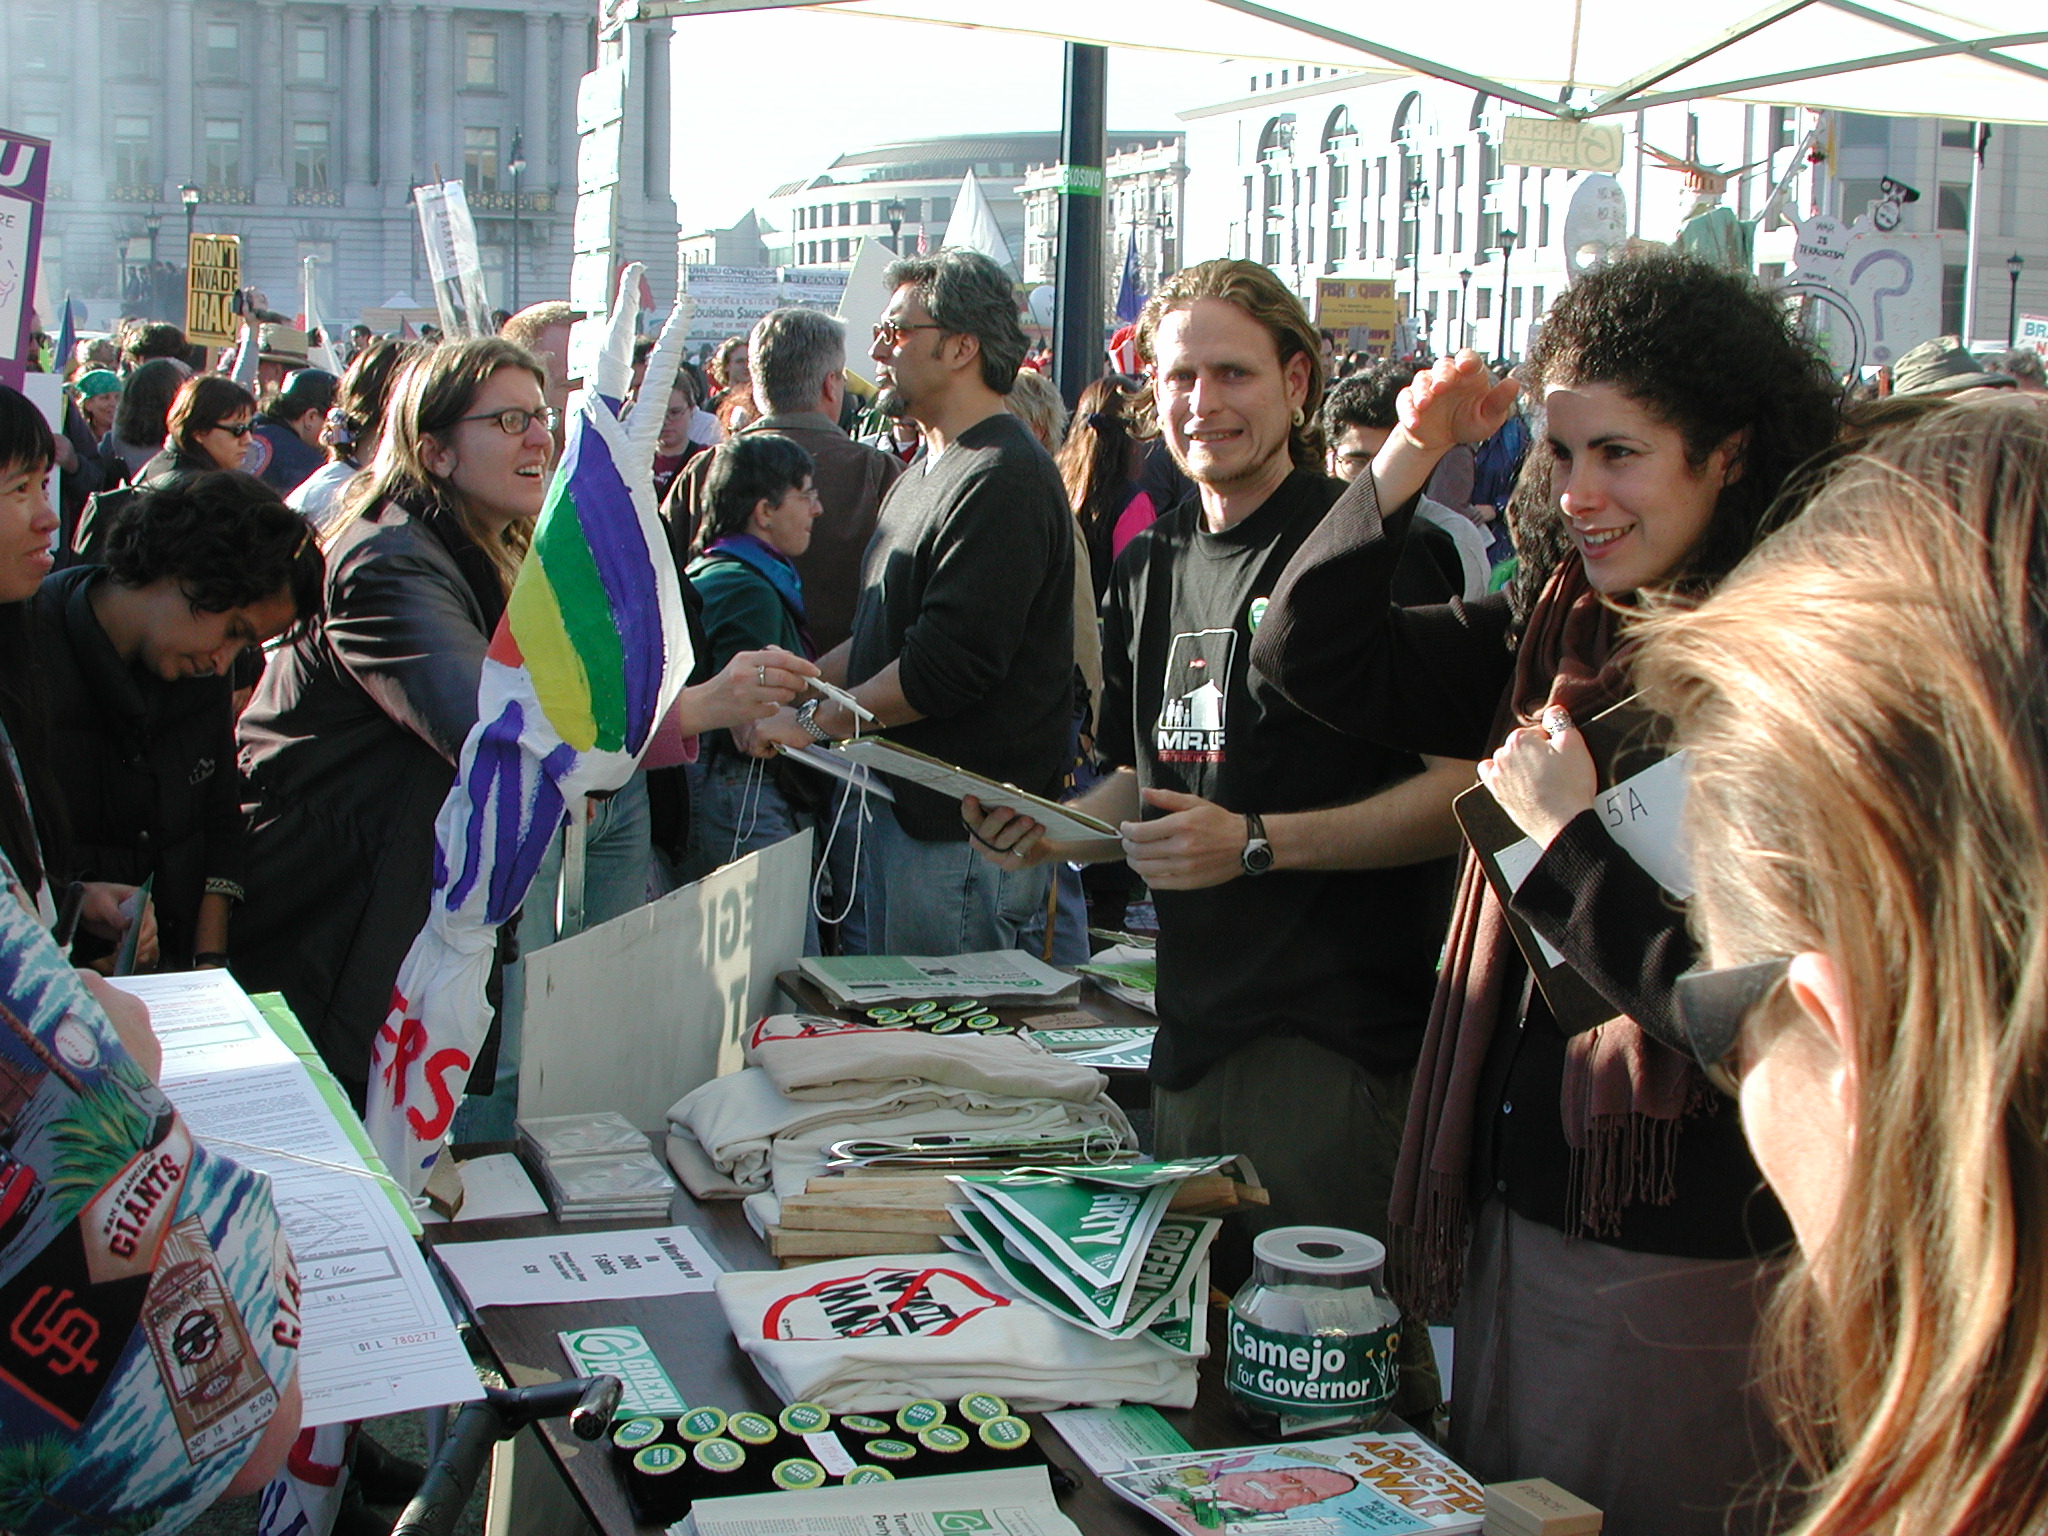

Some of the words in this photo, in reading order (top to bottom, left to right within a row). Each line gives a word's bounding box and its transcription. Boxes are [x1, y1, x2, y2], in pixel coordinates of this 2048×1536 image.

[1069, 168, 1100, 188] KOSOVO
[1816, 221, 1835, 234] WAR
[1817, 235, 1828, 245] IS
[192, 240, 237, 268] DON'T
[1799, 243, 1845, 260] TERRORISM
[192, 268, 238, 291] INVADE
[190, 292, 236, 337] IRAQ
[103, 1208, 118, 1235] SAN
[115, 1152, 156, 1206] FRANCISCO
[108, 1153, 182, 1260] GIANTS
[1070, 1193, 1140, 1245] ARTY
[591, 1253, 618, 1275] T-shirts
[617, 1254, 643, 1270] 2003
[1141, 1225, 1196, 1293] GREEN
[332, 1265, 356, 1277] Voter
[358, 1342, 371, 1352] 01
[376, 1340, 384, 1349] L
[392, 1331, 437, 1346] 780277
[1232, 1321, 1346, 1381] Camejo
[622, 1359, 685, 1411] GREEN
[1236, 1363, 1256, 1387] for
[1257, 1369, 1371, 1400] Governor
[701, 1412, 717, 1429] GREEN
[908, 1411, 931, 1422] PARTY
[913, 1405, 935, 1417] GREEN
[694, 1415, 708, 1433] PARTY
[710, 1444, 726, 1462] PARTY
[717, 1443, 734, 1461] GREEN
[786, 1467, 808, 1481] PARTY
[792, 1463, 814, 1476] GREEN
[1352, 1442, 1486, 1515] ADDICTED
[1359, 1463, 1456, 1518] WAR
